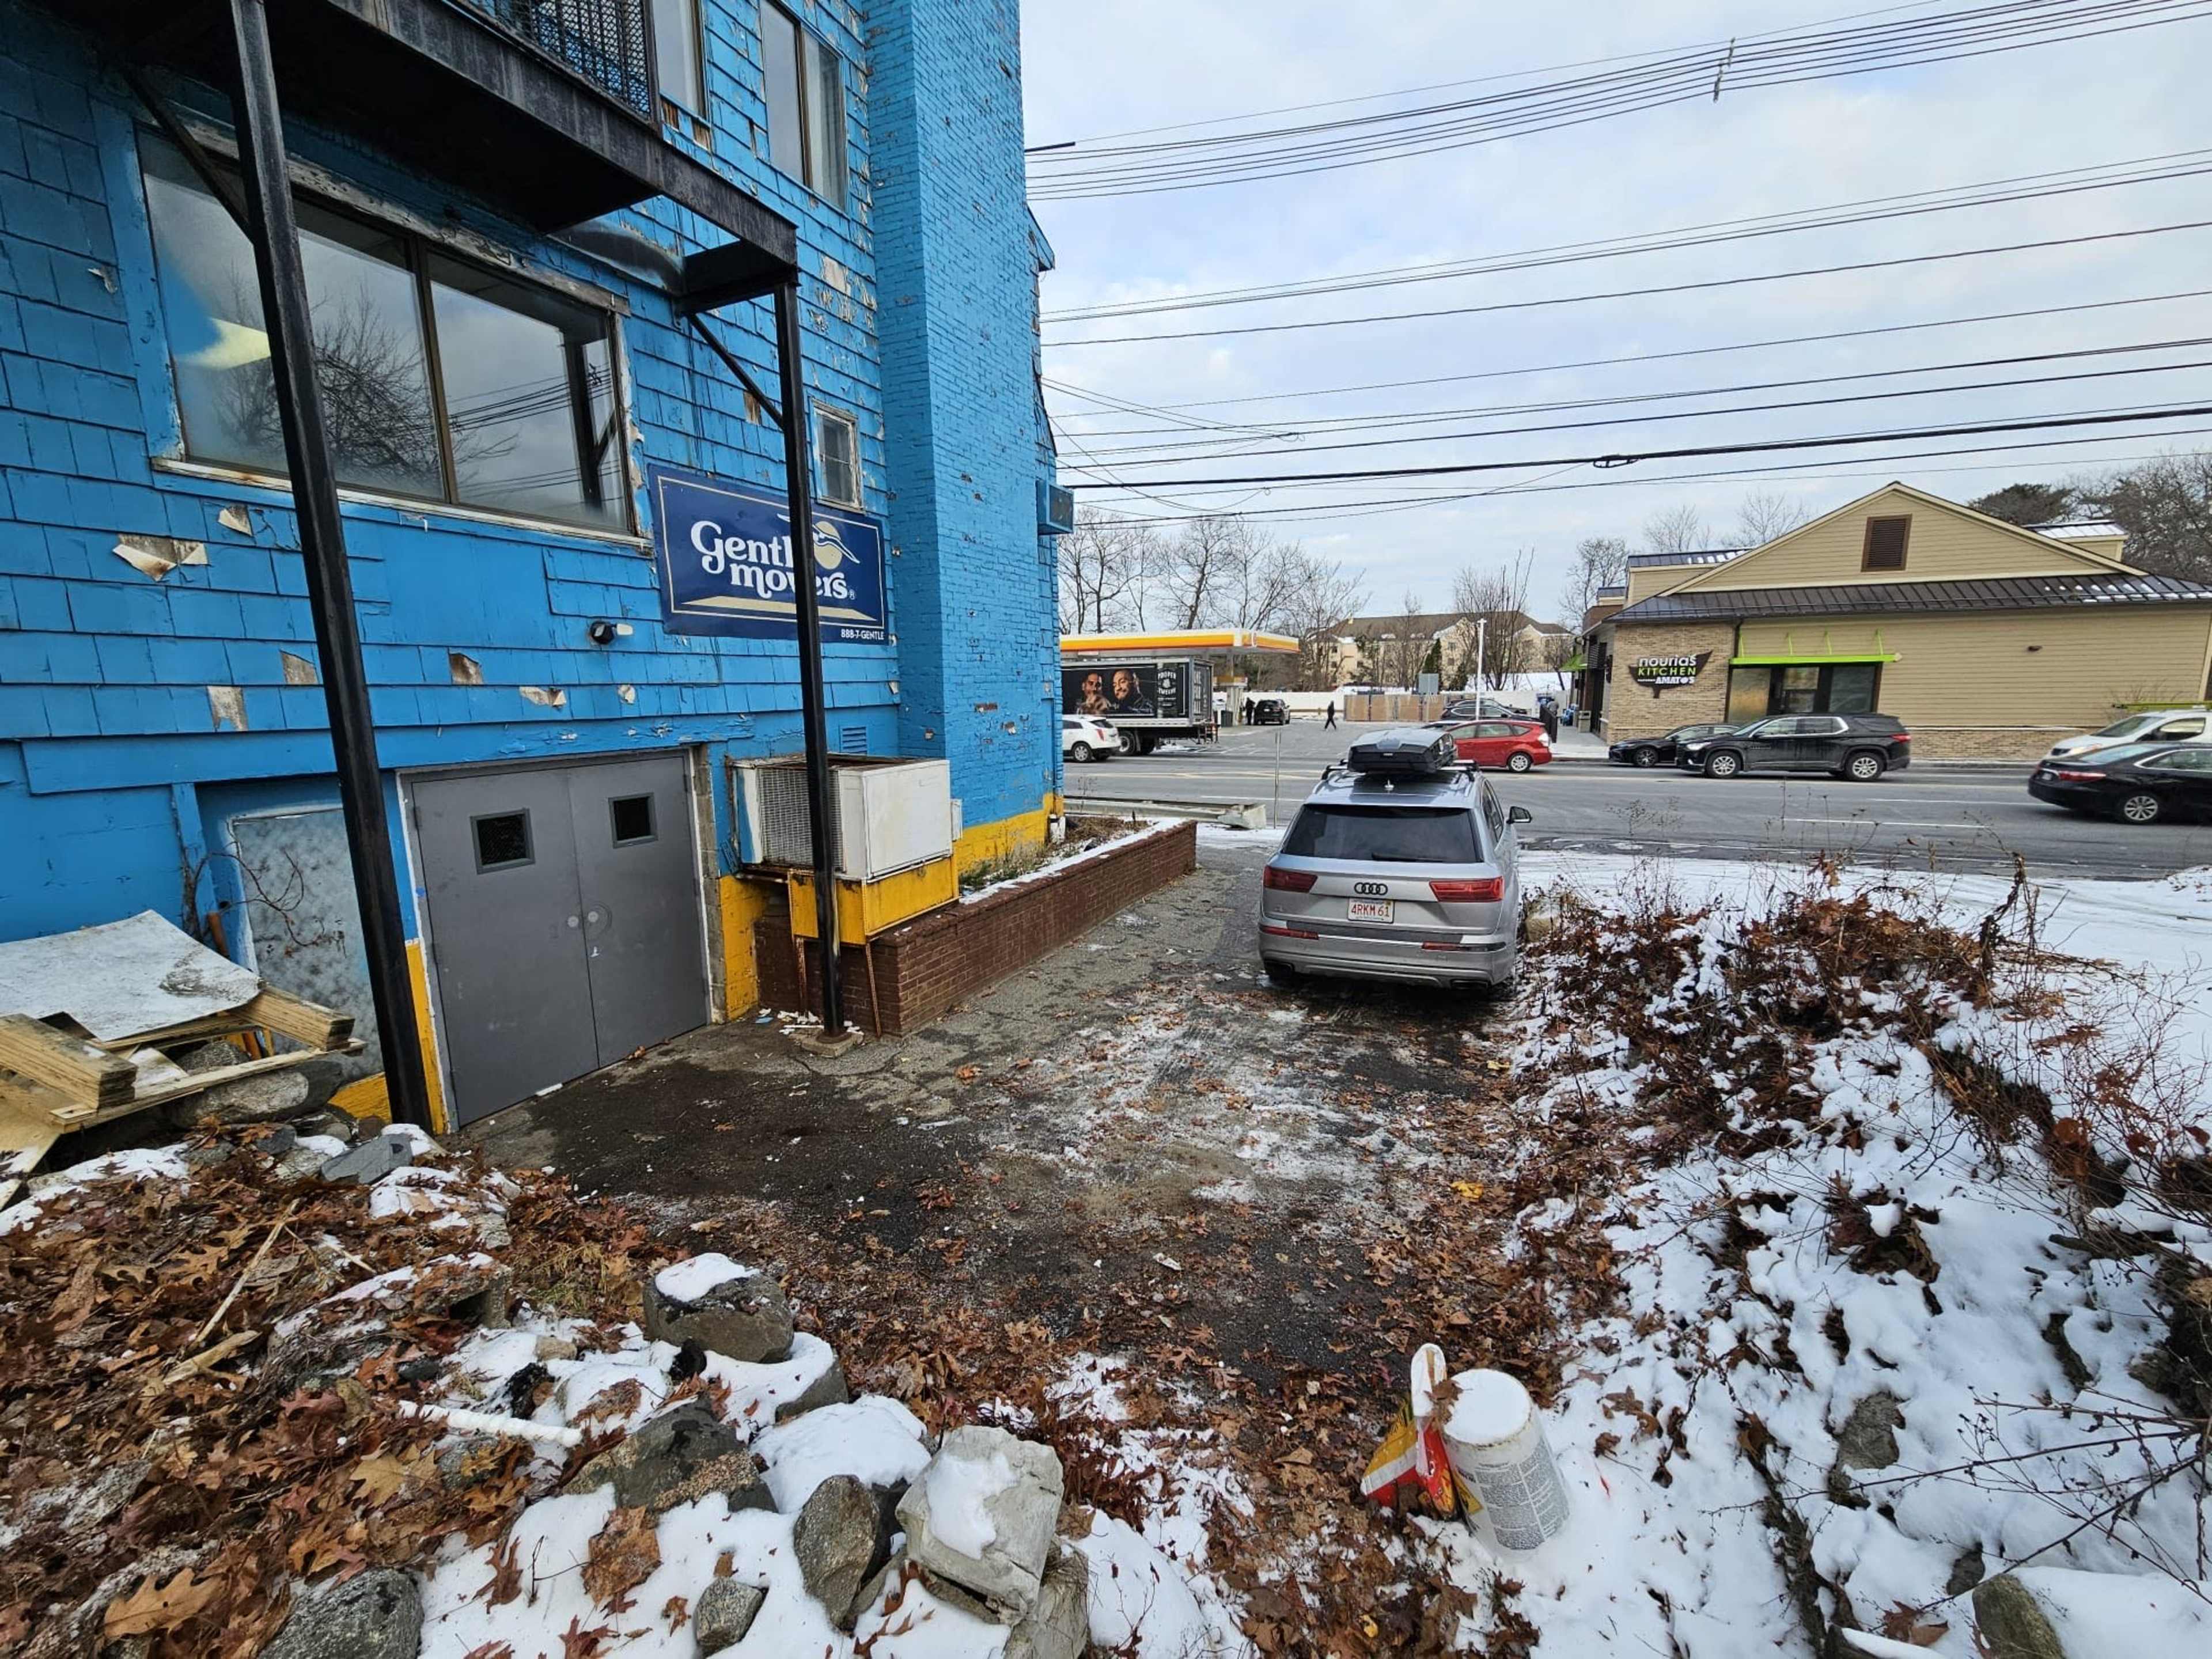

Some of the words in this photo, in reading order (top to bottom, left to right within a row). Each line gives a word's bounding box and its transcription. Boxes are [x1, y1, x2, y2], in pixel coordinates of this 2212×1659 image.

[690, 520, 794, 574] Gentl
[1638, 667, 1696, 676] KITCHEN
[1378, 905, 1389, 917] 61
